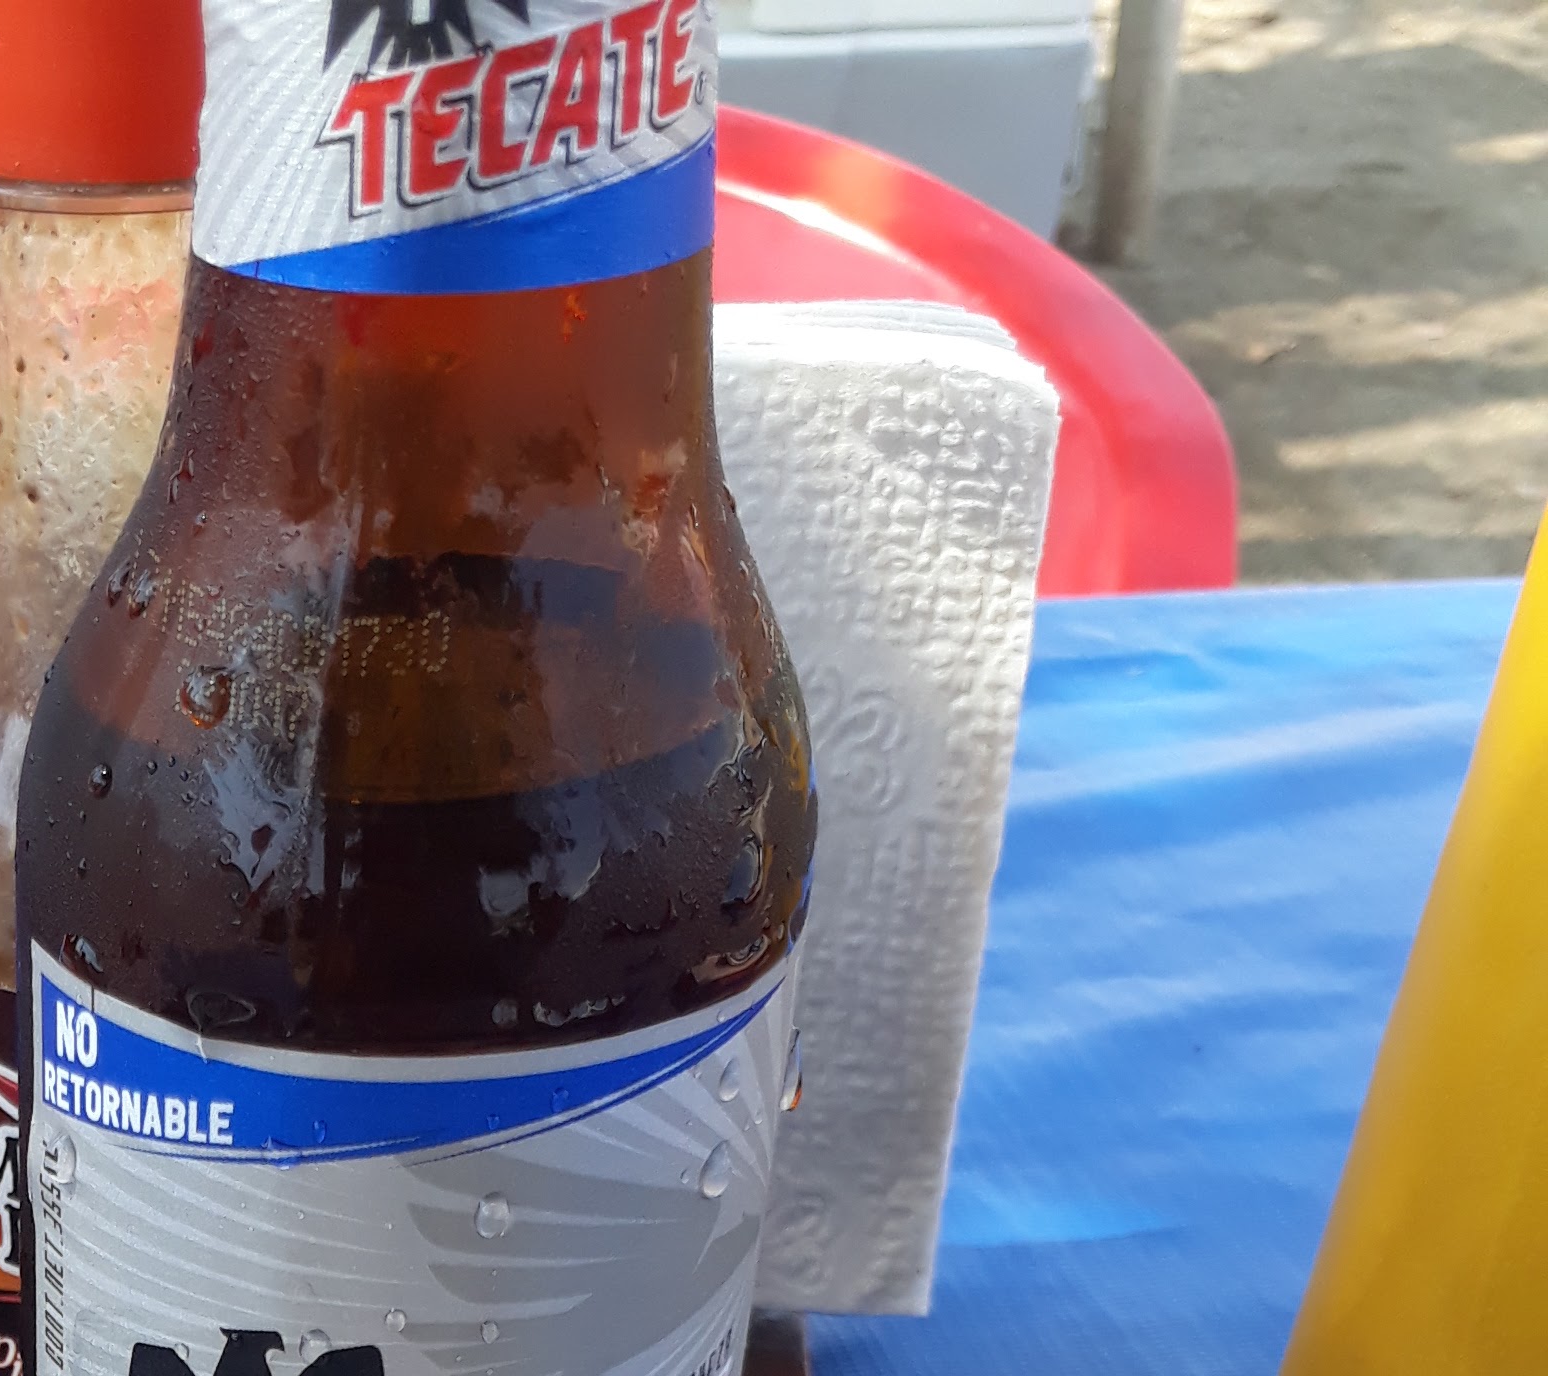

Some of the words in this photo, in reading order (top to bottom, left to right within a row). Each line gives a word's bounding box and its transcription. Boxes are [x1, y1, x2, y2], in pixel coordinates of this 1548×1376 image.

[316, 0, 702, 222] TECATE
[55, 1000, 98, 1068] NO
[44, 1060, 234, 1145] RETORNABLE
